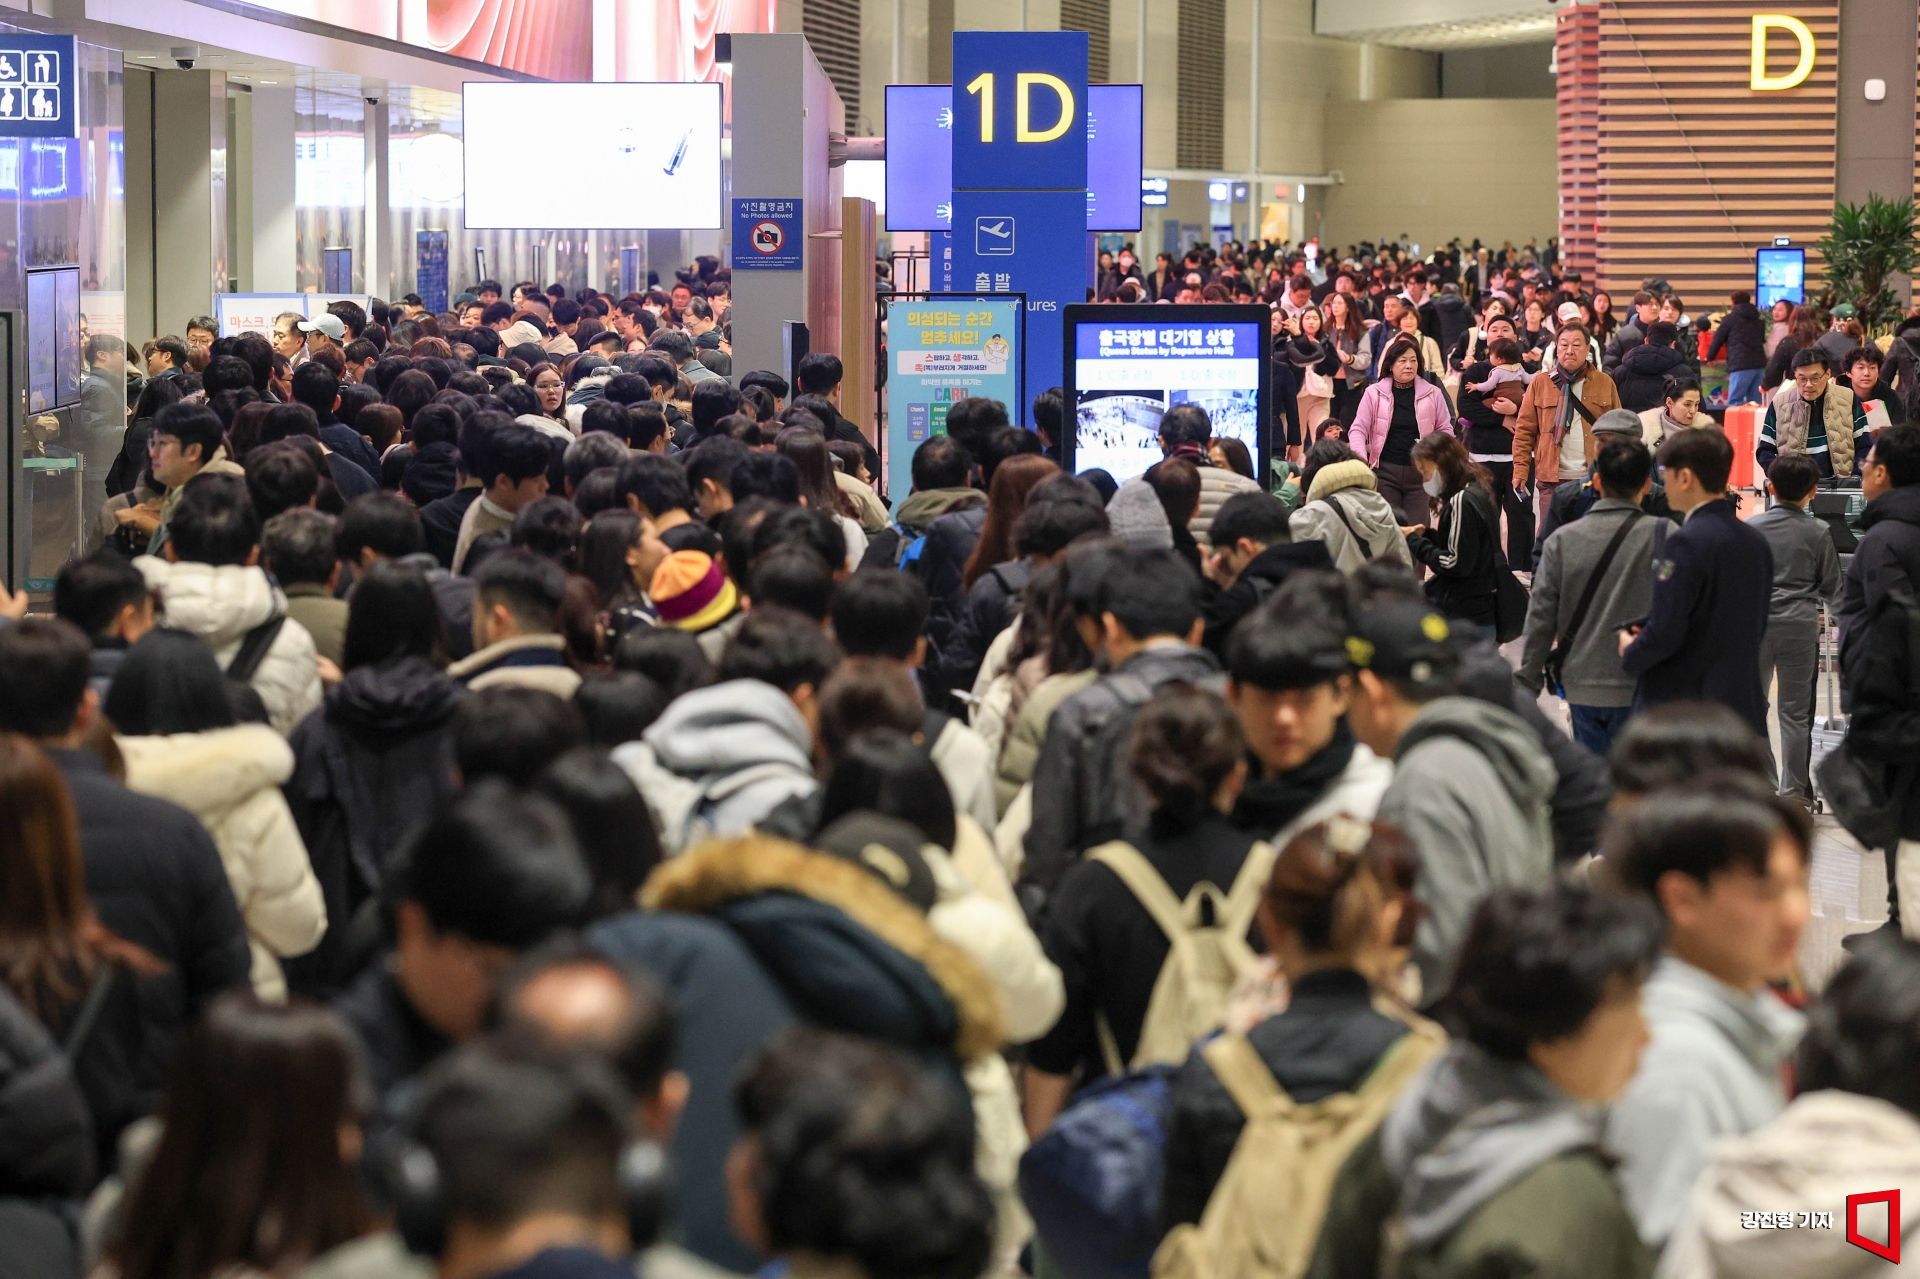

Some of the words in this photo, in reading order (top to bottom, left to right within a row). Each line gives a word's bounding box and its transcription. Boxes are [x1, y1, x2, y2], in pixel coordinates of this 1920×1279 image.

[1751, 14, 1816, 91] D
[966, 72, 1075, 144] 1D
[741, 202, 793, 211] 사진촬영금지
[908, 311, 961, 326] 의심되는
[965, 311, 993, 326] 순간
[921, 331, 980, 345] 멈추세요!
[1099, 329, 1157, 347] 출국장별
[1160, 329, 1203, 347] 대기열
[1206, 329, 1235, 347] 상황
[1100, 346, 1130, 357] (Queue
[1131, 347, 1158, 356] Status
[1159, 346, 1169, 357] by
[1170, 347, 1213, 357] Departure
[1214, 346, 1234, 357] Hall)
[935, 387, 969, 402] CARD
